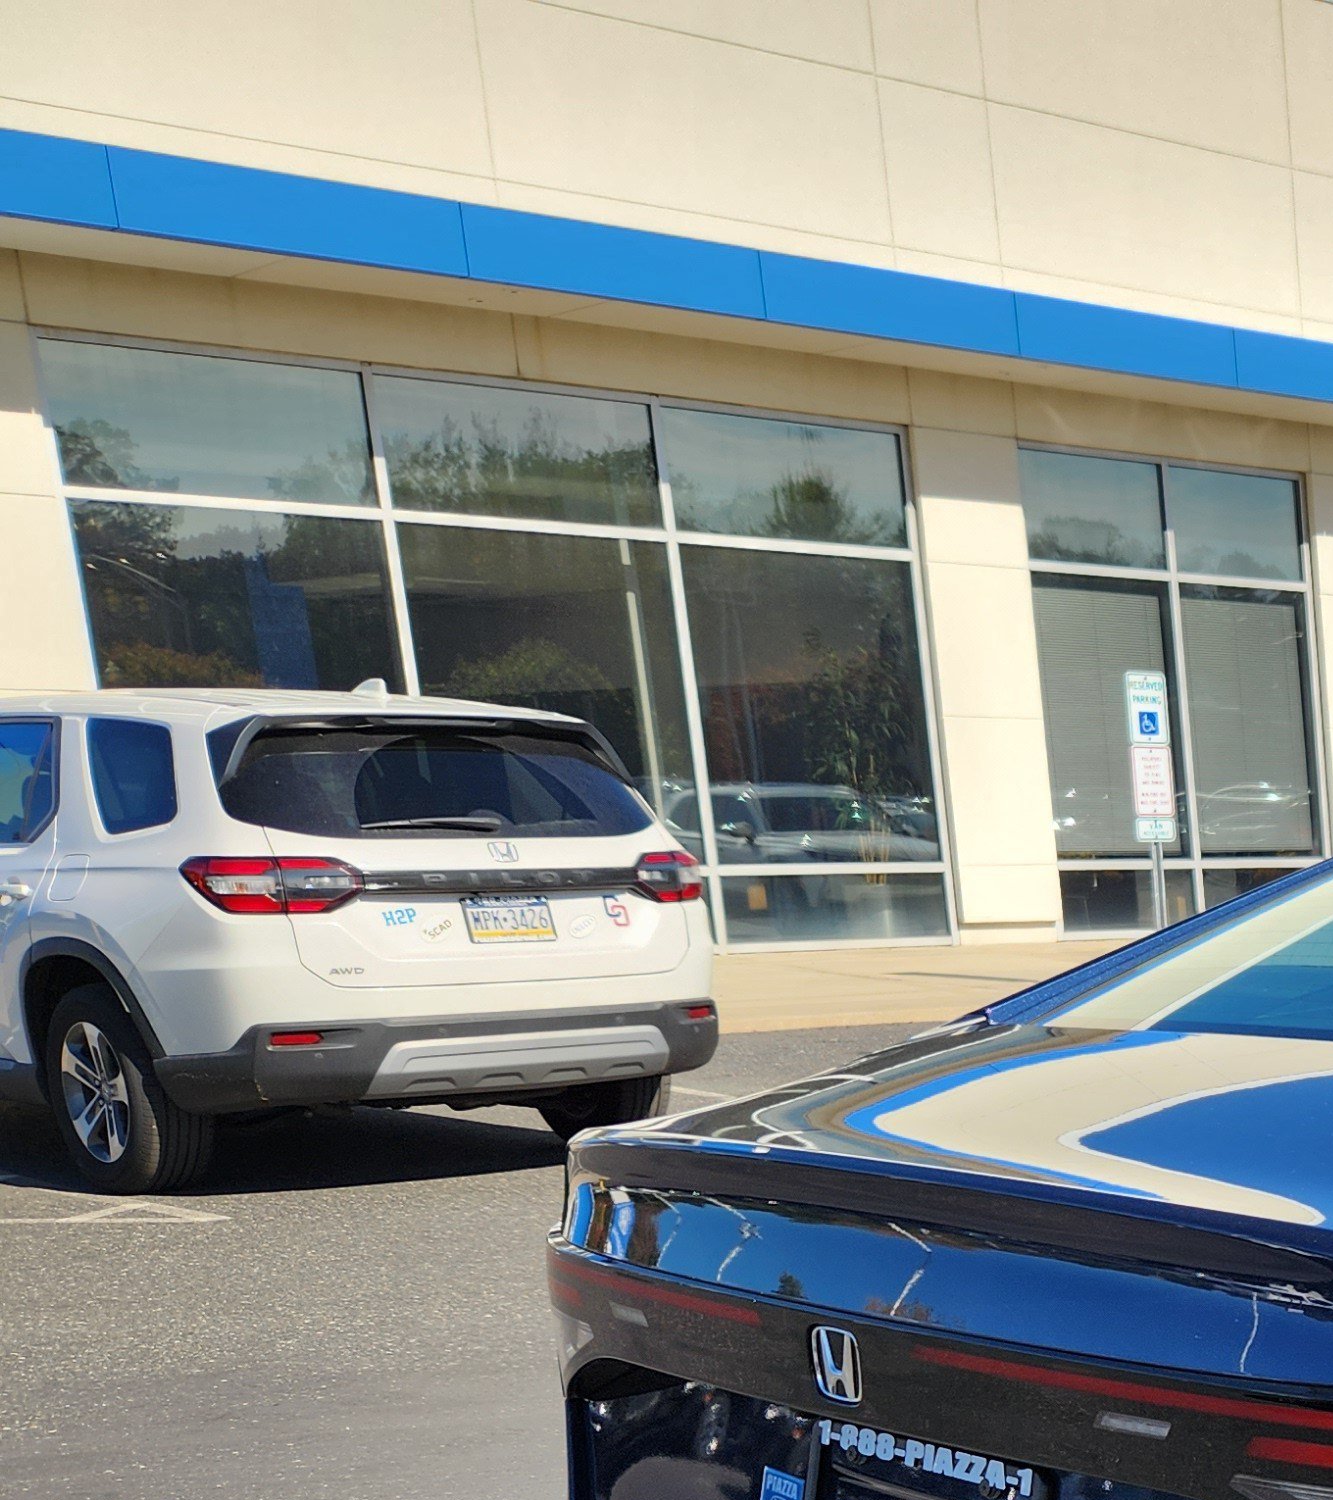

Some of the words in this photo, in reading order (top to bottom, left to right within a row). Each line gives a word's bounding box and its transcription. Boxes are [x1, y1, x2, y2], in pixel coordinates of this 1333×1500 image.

[1133, 695, 1162, 705] PARKING
[422, 869, 595, 887] PILOT
[382, 907, 417, 927] H2P
[329, 967, 365, 976] AWD
[819, 1419, 1033, 1497] 1-888-PIAZZA-1
[766, 1473, 798, 1500] PIAZZA
